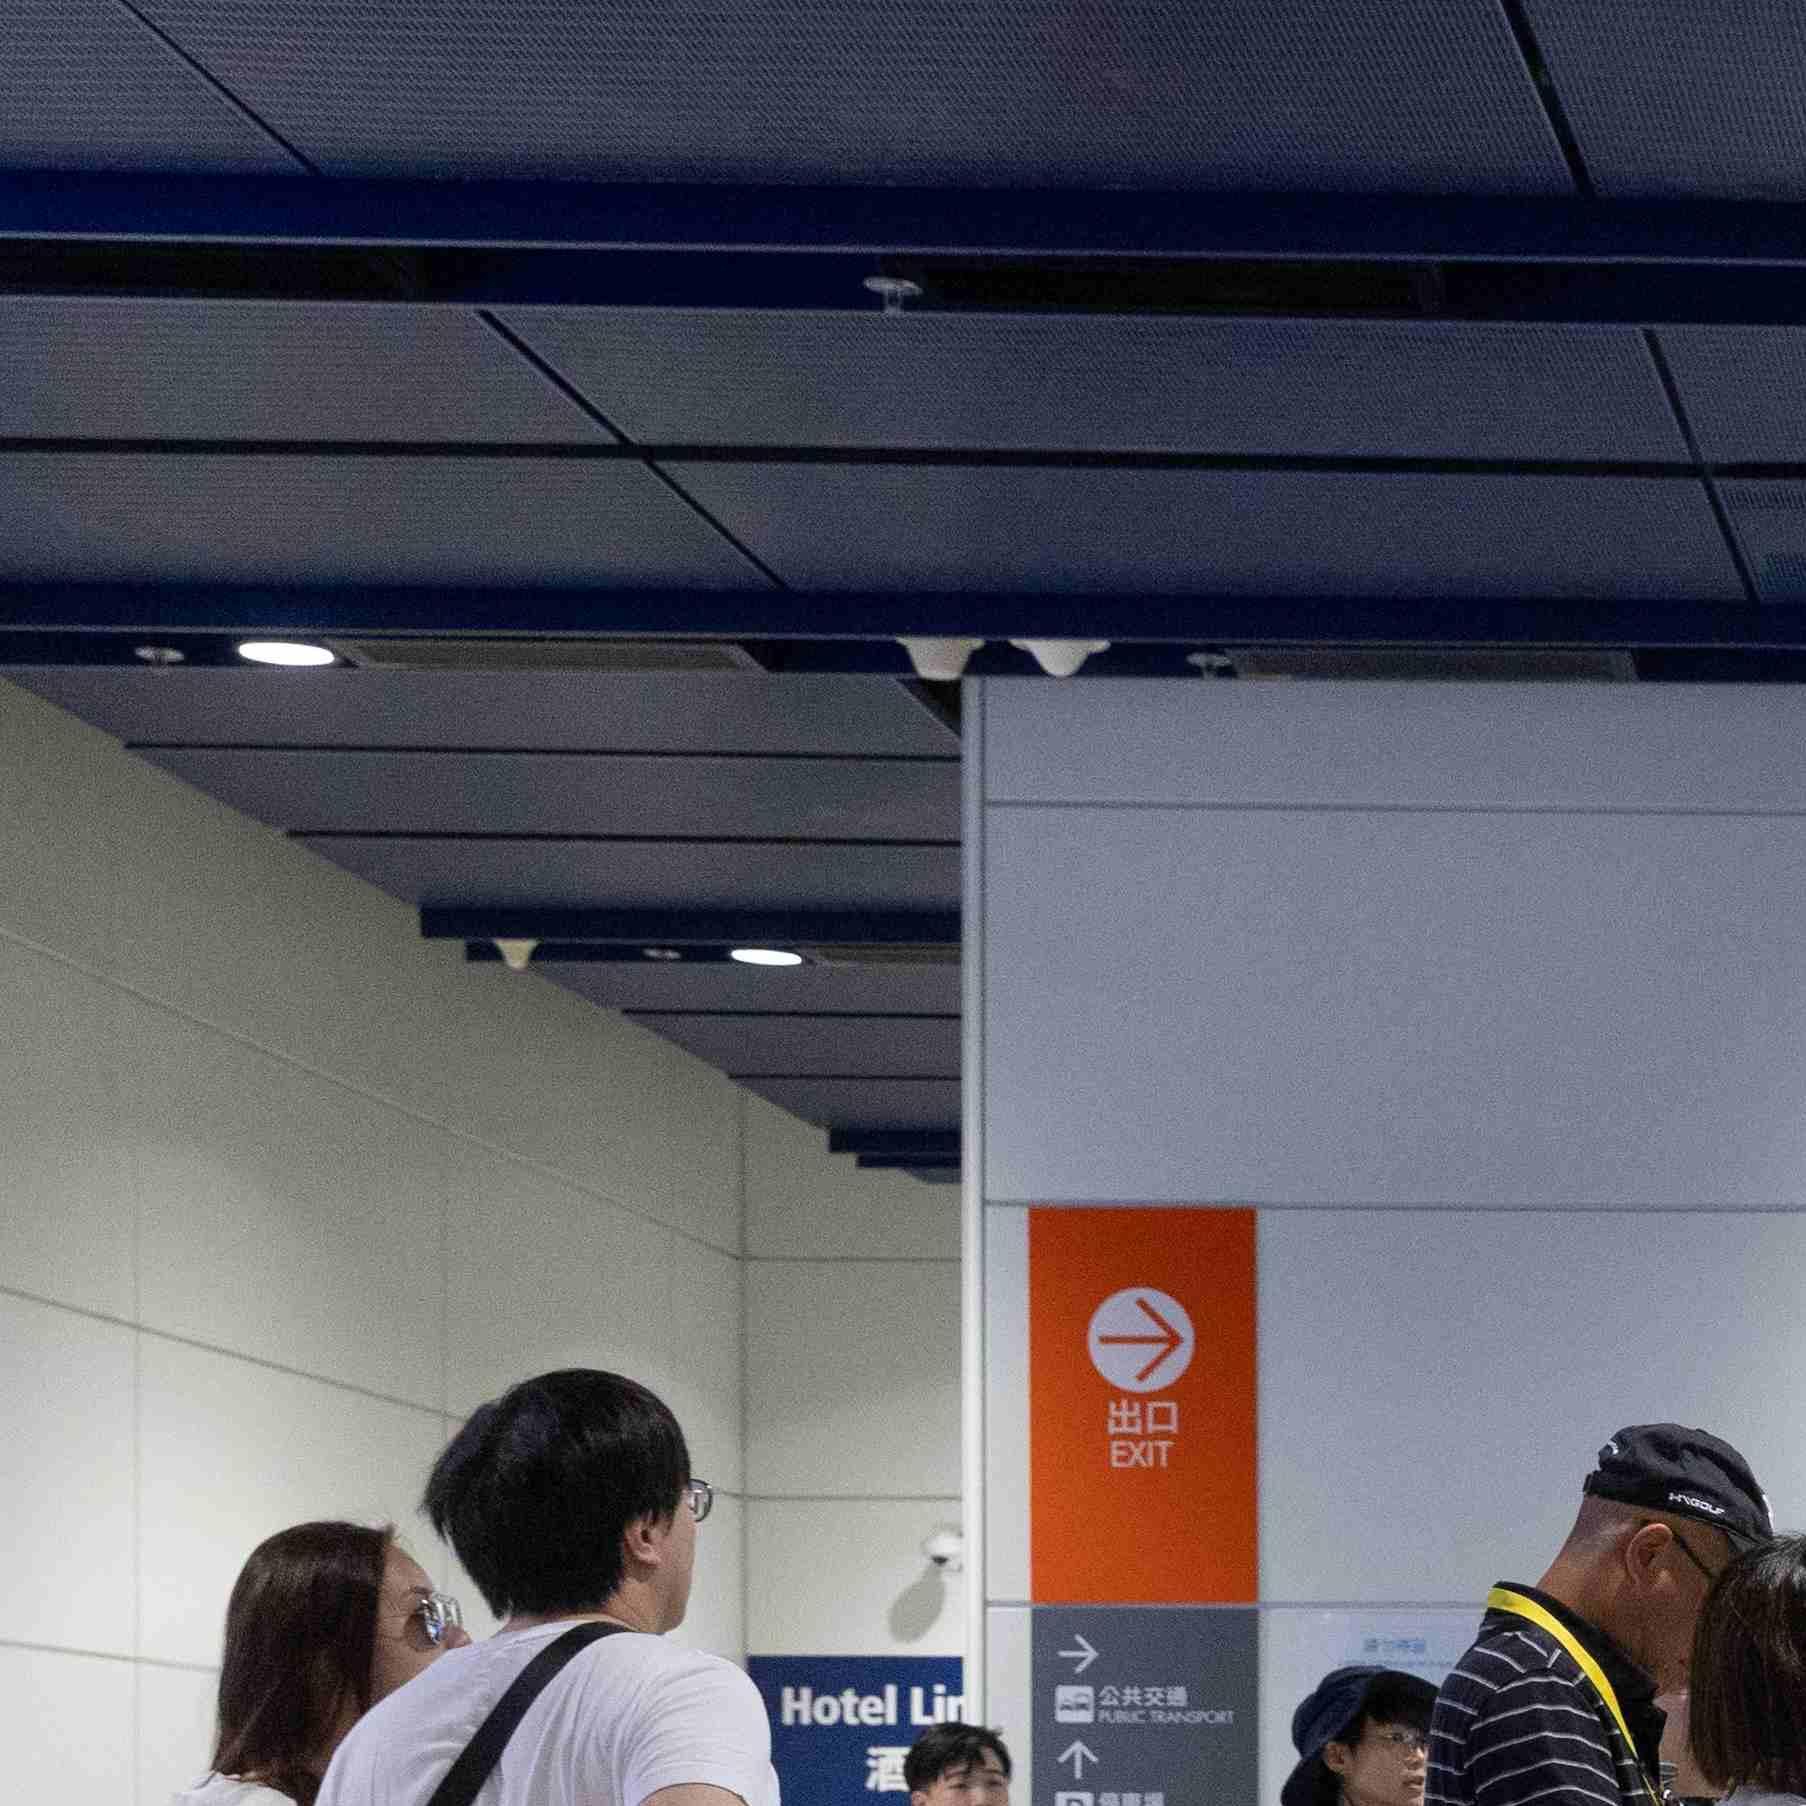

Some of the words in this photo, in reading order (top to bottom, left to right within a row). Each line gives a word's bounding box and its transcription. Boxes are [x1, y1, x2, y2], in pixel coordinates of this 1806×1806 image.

[1107, 1399, 1179, 1435] 出口
[1110, 1440, 1176, 1469] EXIT
[781, 1683, 898, 1726] Hotel
[1099, 1685, 1188, 1707] 公共交通
[1099, 1710, 1146, 1724] PUBLIC
[1149, 1710, 1234, 1724] TRANSPORT
